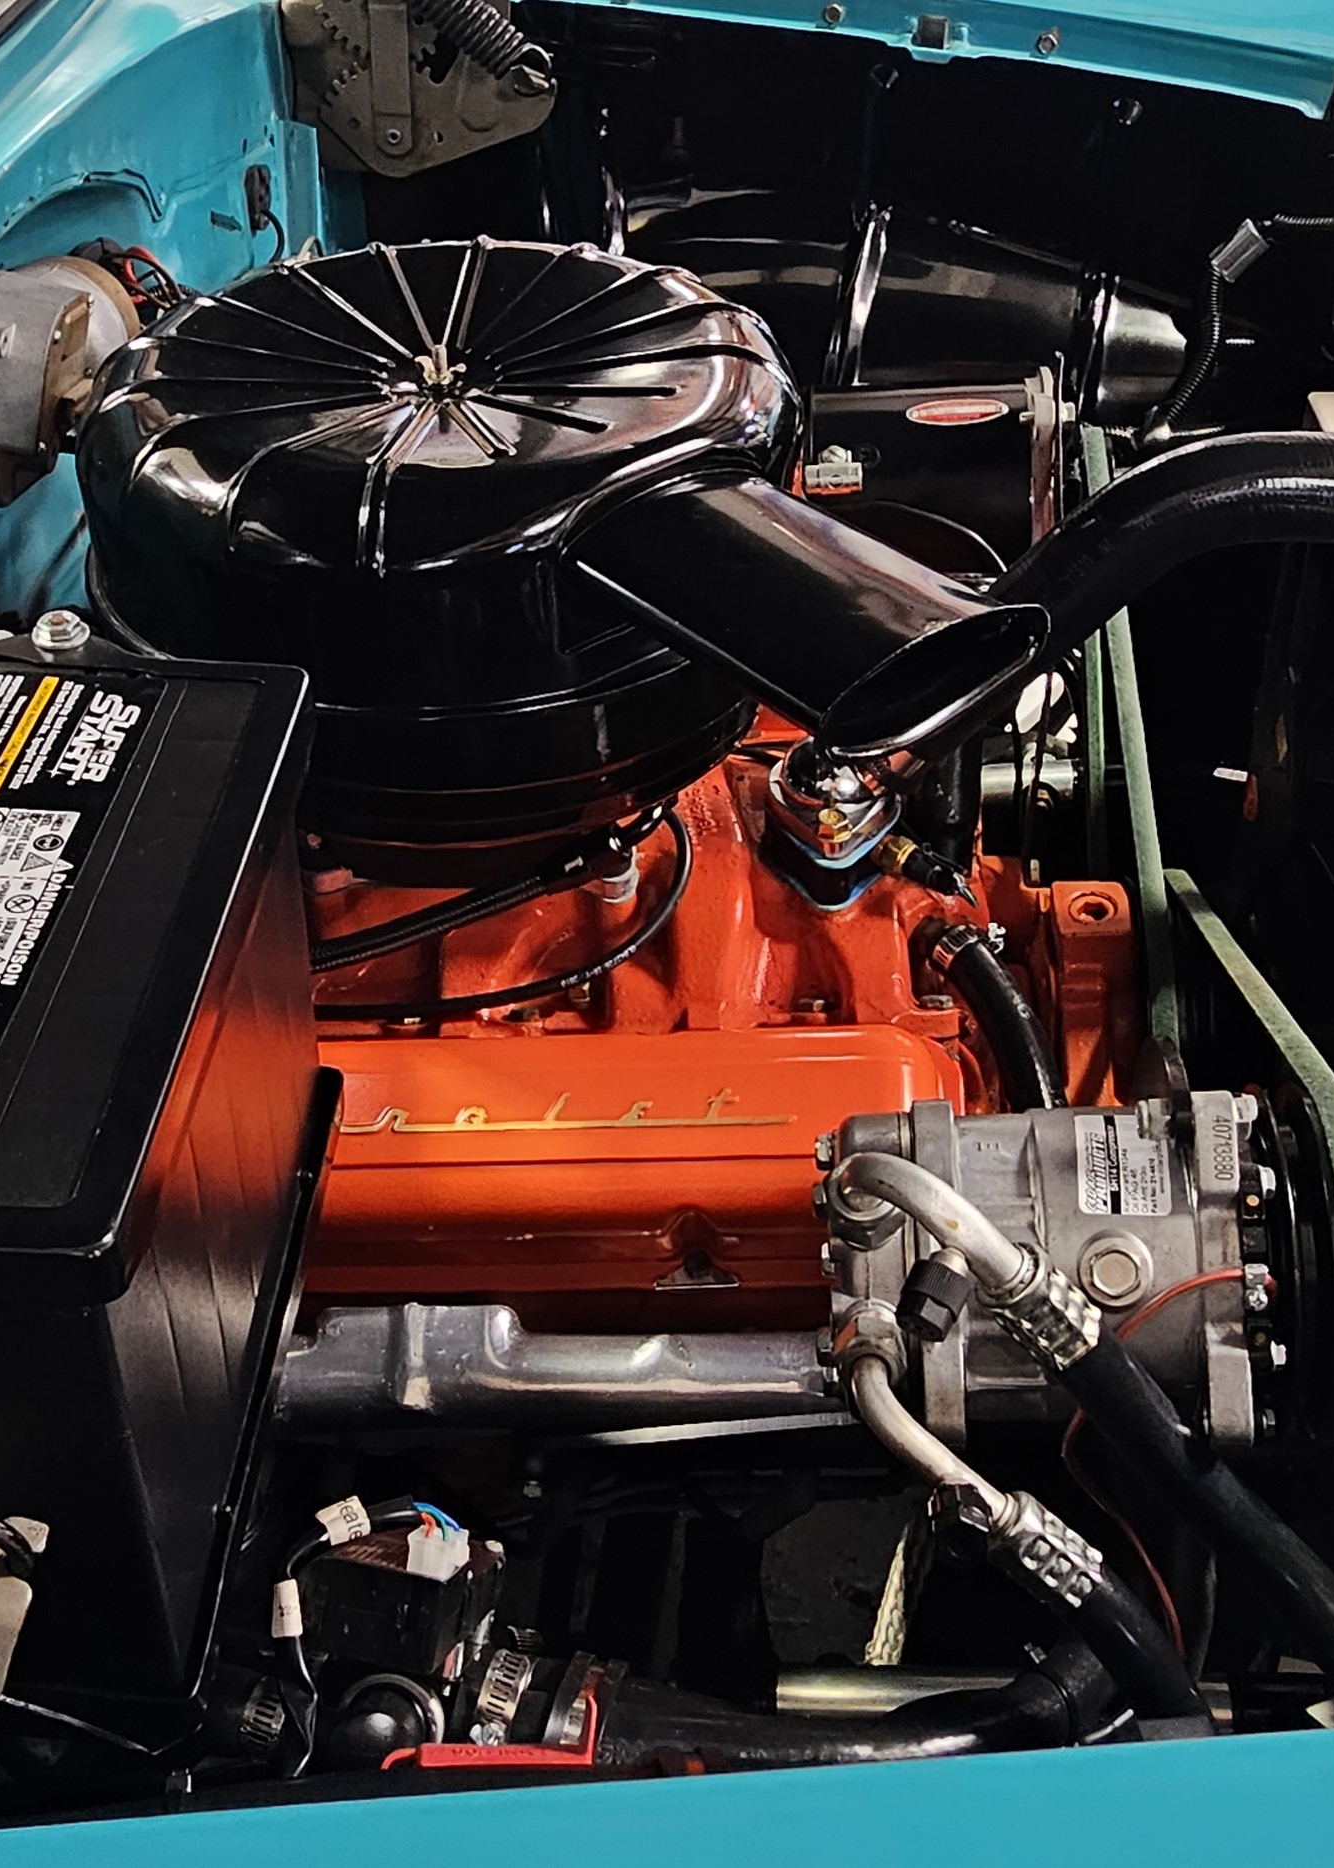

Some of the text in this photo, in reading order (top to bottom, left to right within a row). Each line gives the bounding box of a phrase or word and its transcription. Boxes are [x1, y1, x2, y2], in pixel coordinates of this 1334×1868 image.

[57, 690, 124, 781] START
[85, 702, 142, 782] SUPER
[0, 872, 67, 985] DANGER/POISON
[1212, 1114, 1234, 1181] 40713880
